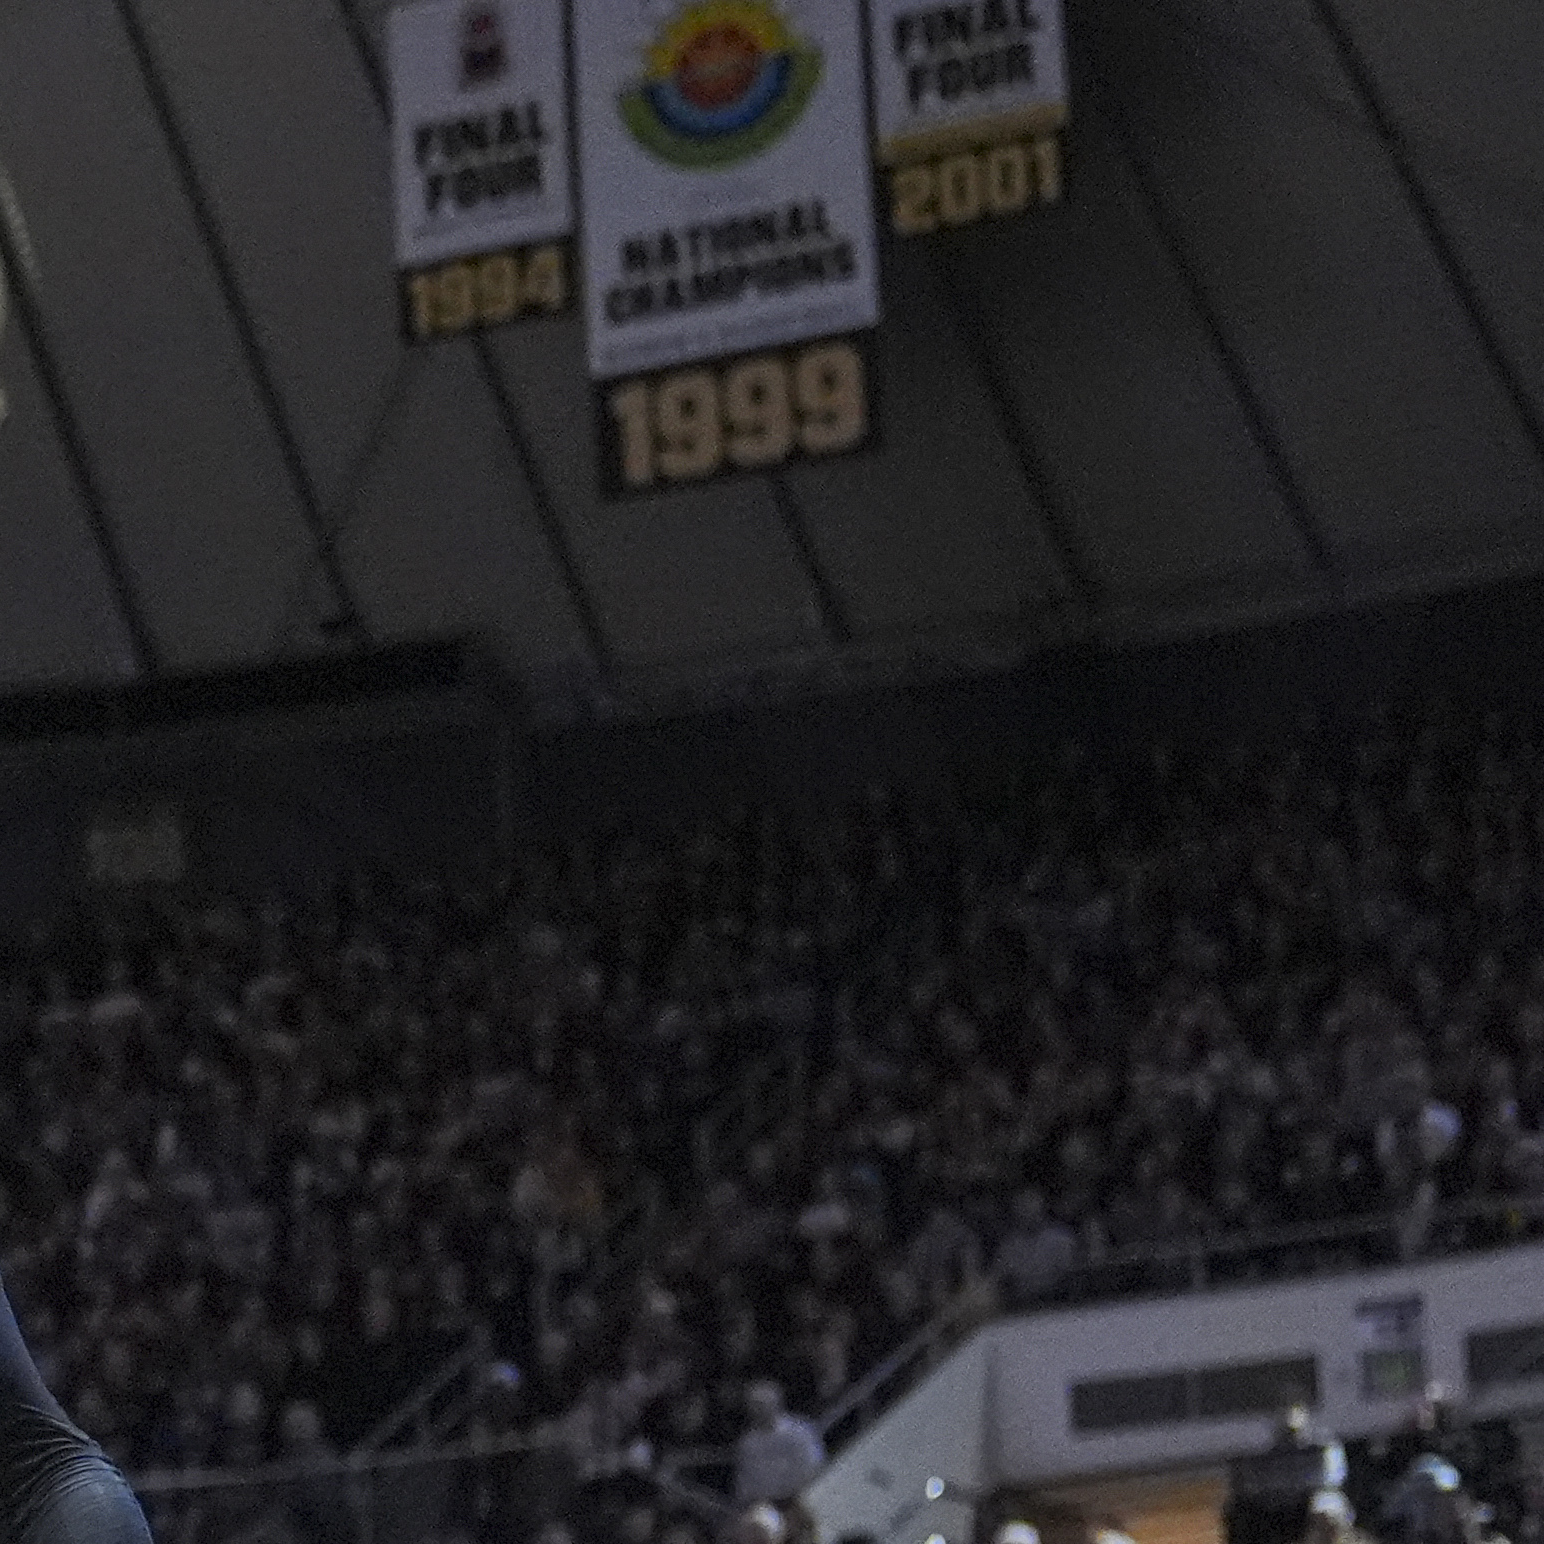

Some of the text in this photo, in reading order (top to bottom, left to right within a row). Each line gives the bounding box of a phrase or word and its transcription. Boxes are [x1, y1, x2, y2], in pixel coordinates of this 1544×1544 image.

[892, 0, 1041, 60] FINAL
[907, 42, 1036, 113] FOUR
[414, 100, 544, 168] FINAL
[425, 153, 543, 215] FOUR
[889, 138, 1061, 237] 2001
[620, 197, 833, 275] NATIONAL
[604, 240, 857, 327] CHAMPIONS
[609, 340, 867, 490] 1999
